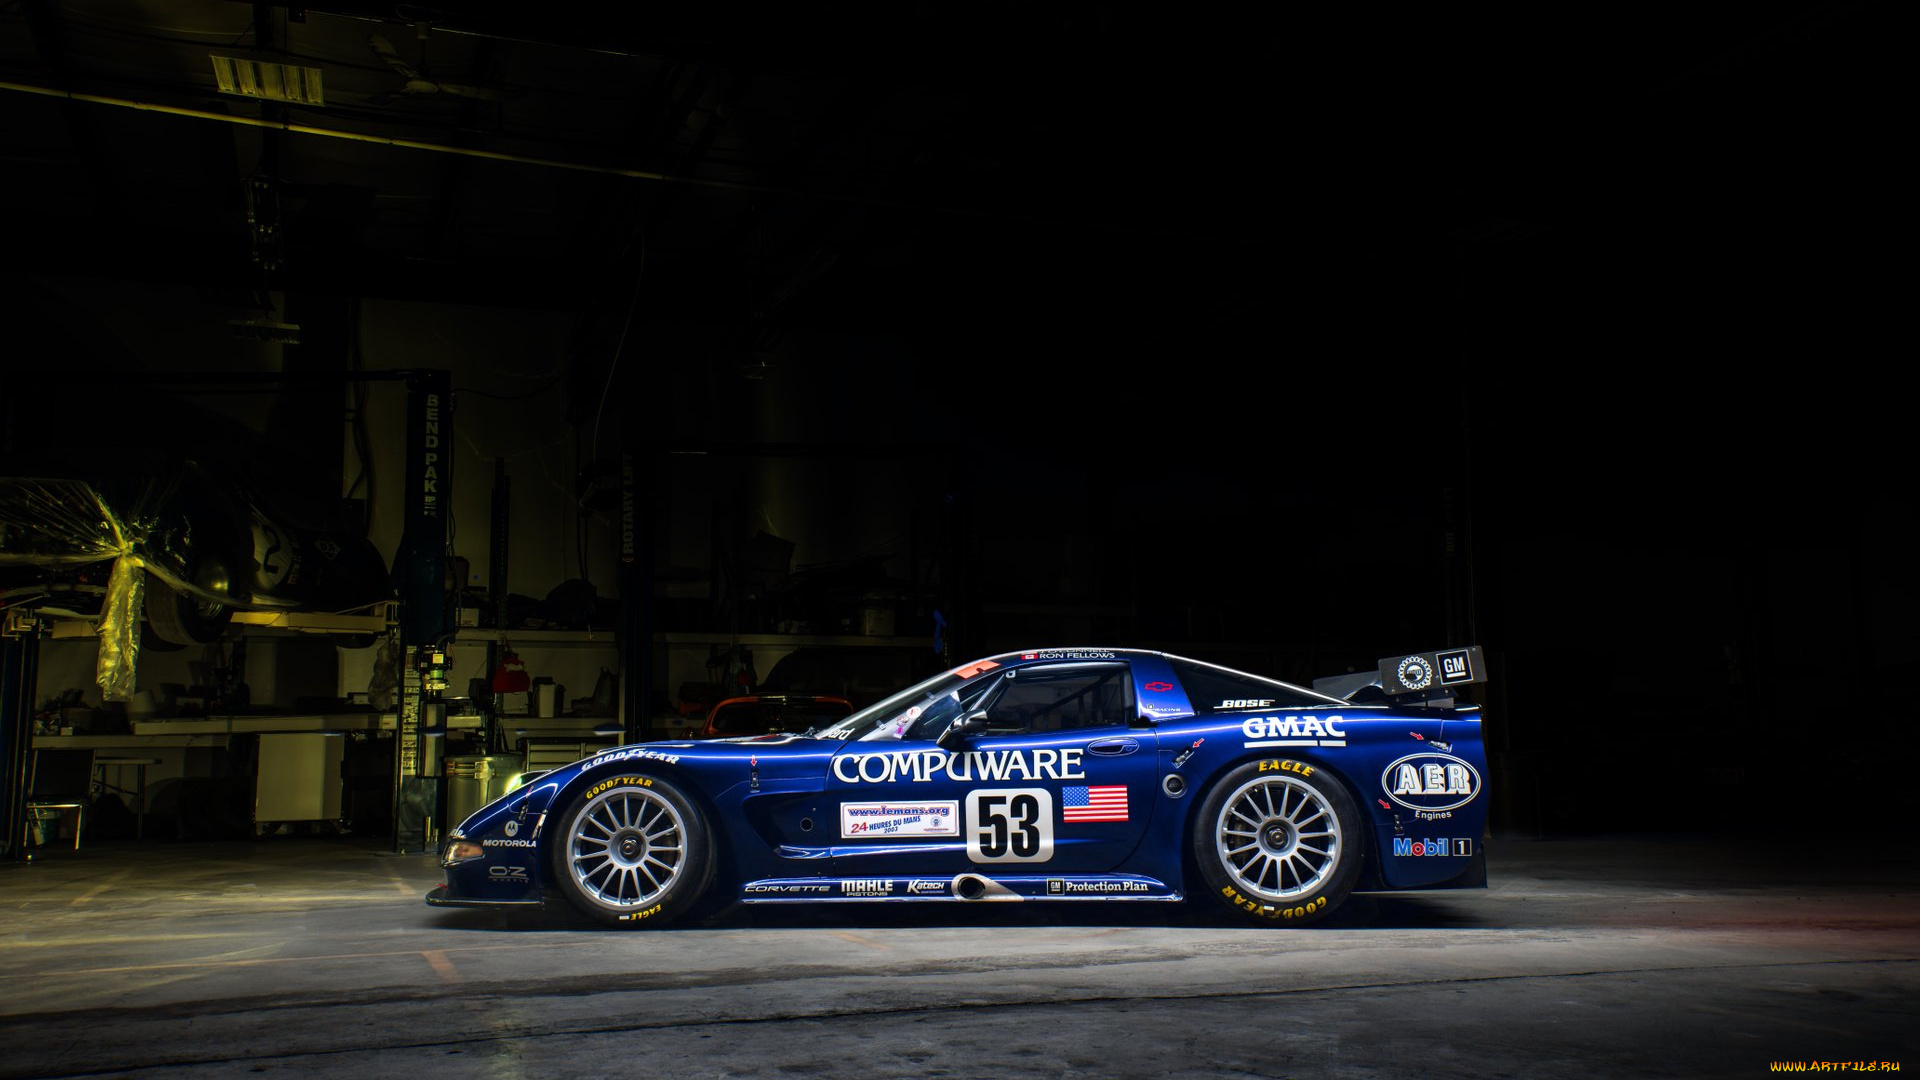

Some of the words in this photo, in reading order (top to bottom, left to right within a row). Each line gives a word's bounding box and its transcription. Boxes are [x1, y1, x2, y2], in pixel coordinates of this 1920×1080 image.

[1443, 656, 1466, 674] GM
[1221, 699, 1275, 708] BOSE
[1242, 715, 1346, 739] GMAC
[581, 748, 680, 771] GOODYEAR
[833, 748, 1086, 783] COMPUWARE
[1258, 759, 1315, 777] EAGLE
[586, 777, 653, 799] GOODYEAR
[1393, 763, 1472, 795] AER
[847, 805, 950, 818] www.lemans.org
[1415, 810, 1452, 821] Engines
[850, 822, 869, 834] 24
[869, 820, 892, 831] HEURES
[893, 818, 902, 827] DU
[903, 815, 921, 825] MANS
[977, 793, 1041, 858] 53
[482, 839, 537, 848] MOTOROLA
[1393, 837, 1449, 857] Mobil
[840, 879, 893, 892] MAHLE
[1065, 881, 1121, 892] Protection
[1122, 881, 1149, 892] Plan
[630, 903, 662, 921] EAGLE
